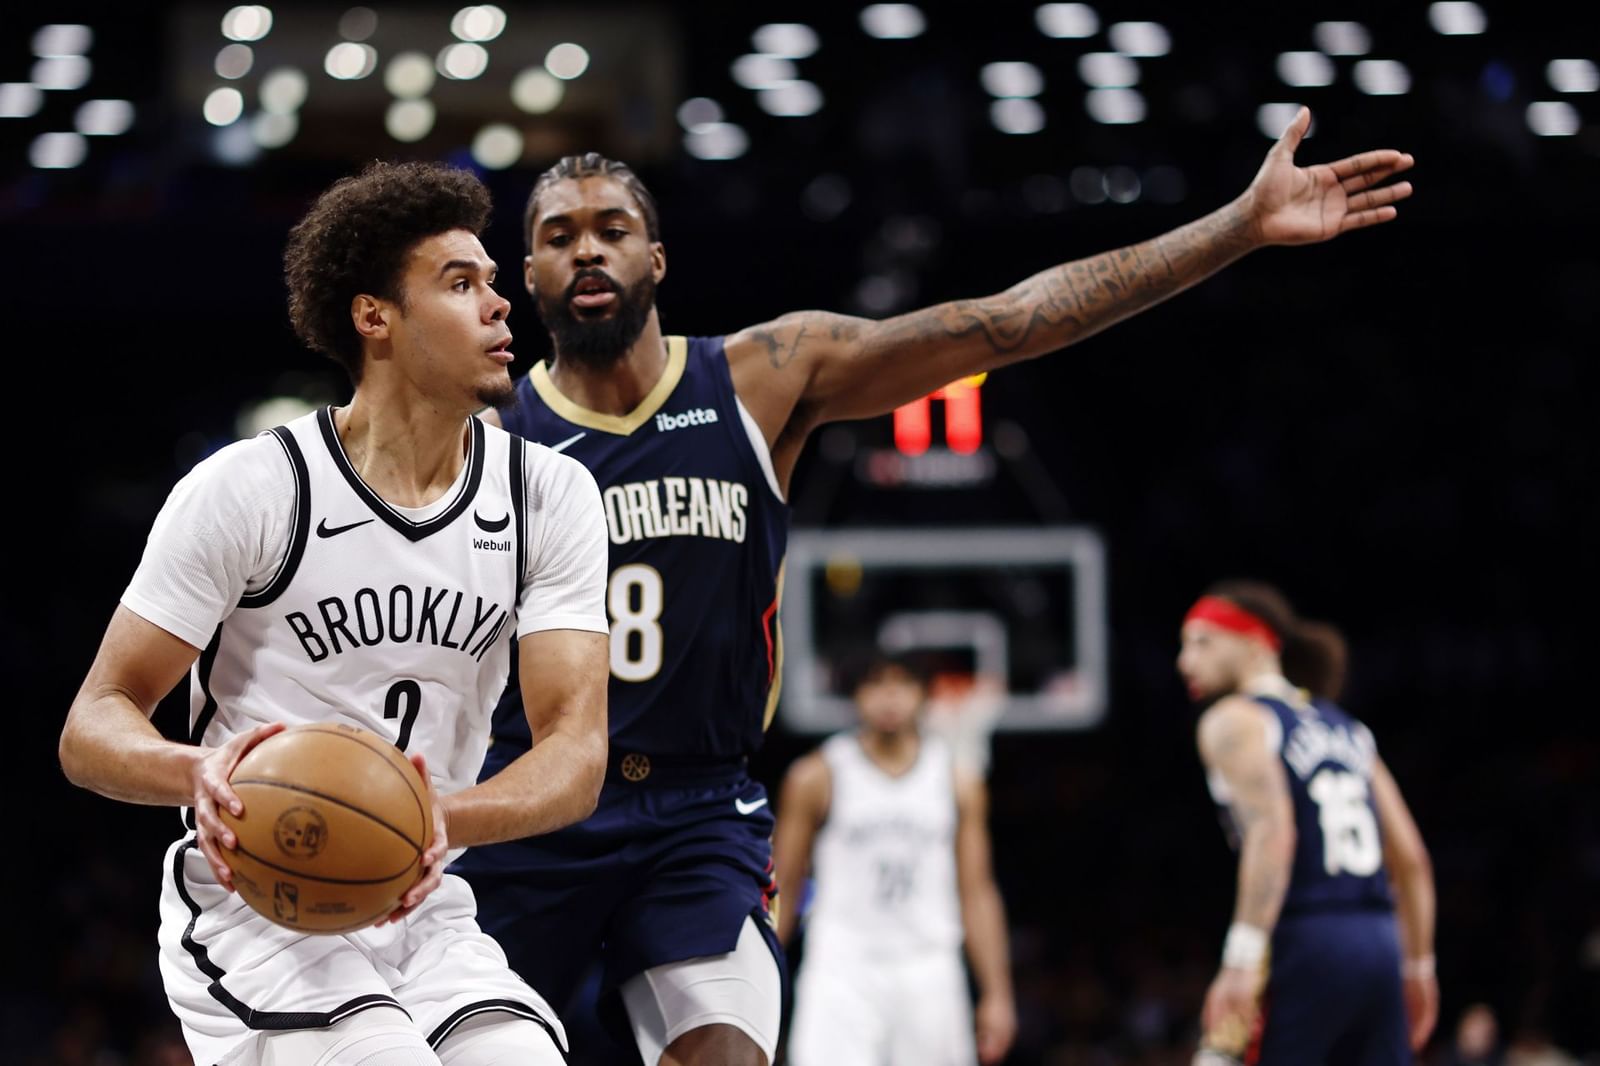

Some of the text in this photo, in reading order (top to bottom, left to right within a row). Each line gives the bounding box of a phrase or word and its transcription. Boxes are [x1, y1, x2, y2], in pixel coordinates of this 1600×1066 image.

[655, 407, 719, 433] ibotta
[472, 538, 511, 553] Webull
[603, 476, 748, 545] ORLEANS
[285, 583, 510, 663] BROOKLYN
[608, 563, 664, 683] 8
[384, 679, 422, 753] 2
[1307, 767, 1383, 877] 15
